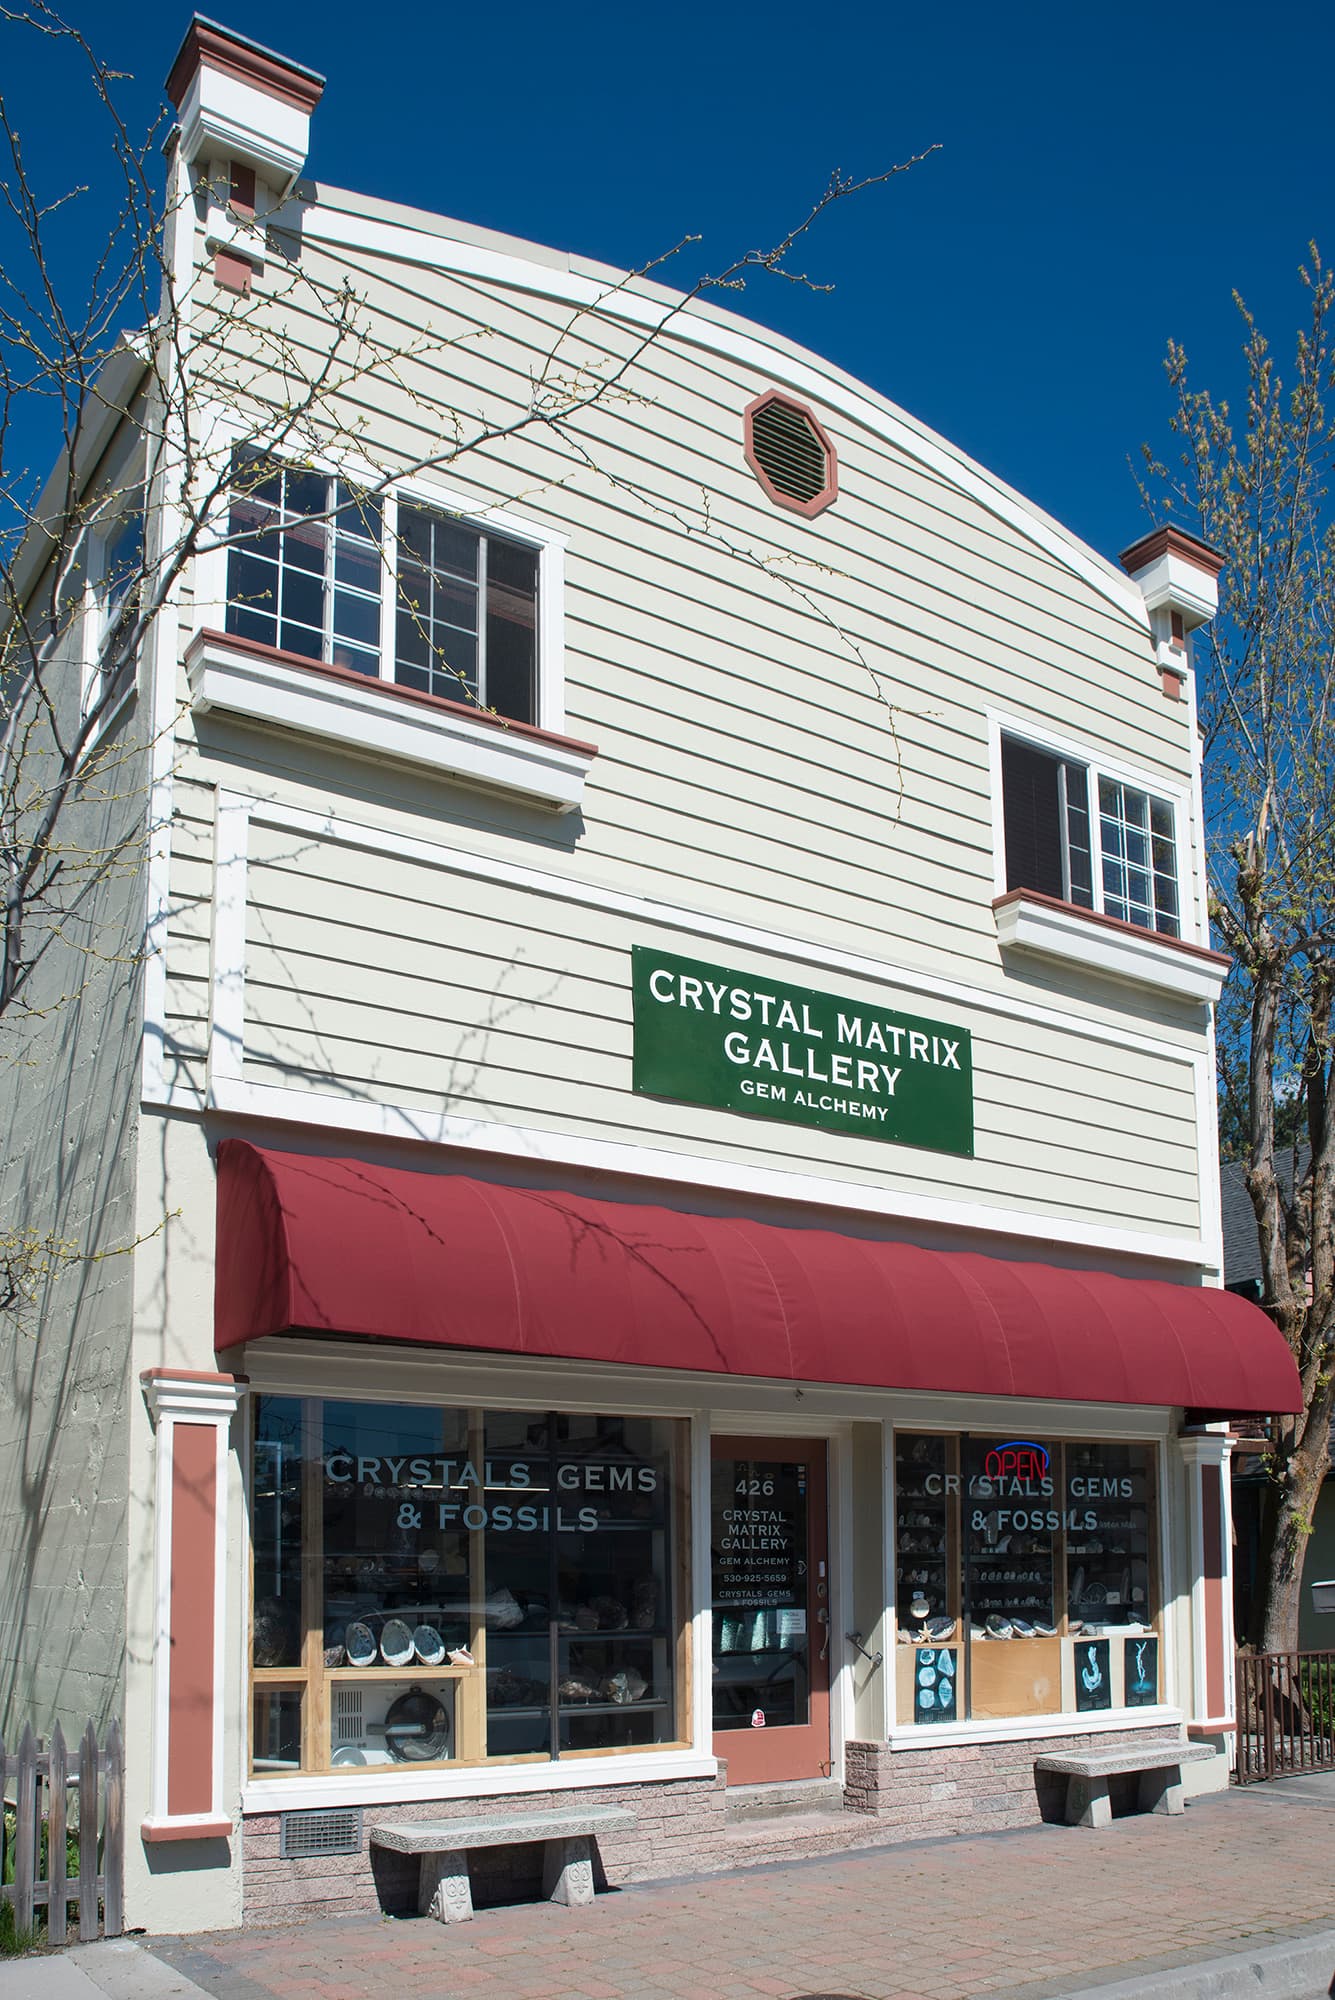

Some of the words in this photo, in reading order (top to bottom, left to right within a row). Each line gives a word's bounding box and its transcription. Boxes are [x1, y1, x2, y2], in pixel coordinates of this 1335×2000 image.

[649, 969, 823, 1040] CRYSTAL
[836, 1013, 962, 1071] MATRIX
[724, 1031, 902, 1097] GALLERY
[740, 1079, 786, 1101] GEM
[793, 1091, 889, 1122] ALCHEMY
[325, 1455, 531, 1488] CRYSTALS
[556, 1464, 658, 1492] GEMS
[985, 1450, 1046, 1480] OPEN
[735, 1479, 775, 1496] 426
[1070, 1477, 1133, 1498] GEMS
[397, 1503, 422, 1529] &
[439, 1503, 599, 1532] FOSSILS
[722, 1509, 787, 1522] CRYSTAL
[971, 1510, 988, 1531] &
[998, 1510, 1097, 1531] FOSSILS
[728, 1524, 781, 1536] MATRIX
[721, 1537, 788, 1550] GALLERY
[719, 1557, 741, 1565] GEM
[743, 1557, 790, 1566] ALCHEMY
[723, 1574, 787, 1583] 530-925-5659
[719, 1590, 763, 1599] CRYSTALS
[767, 1590, 791, 1598] GEMS
[742, 1599, 778, 1607] FOSSILS
